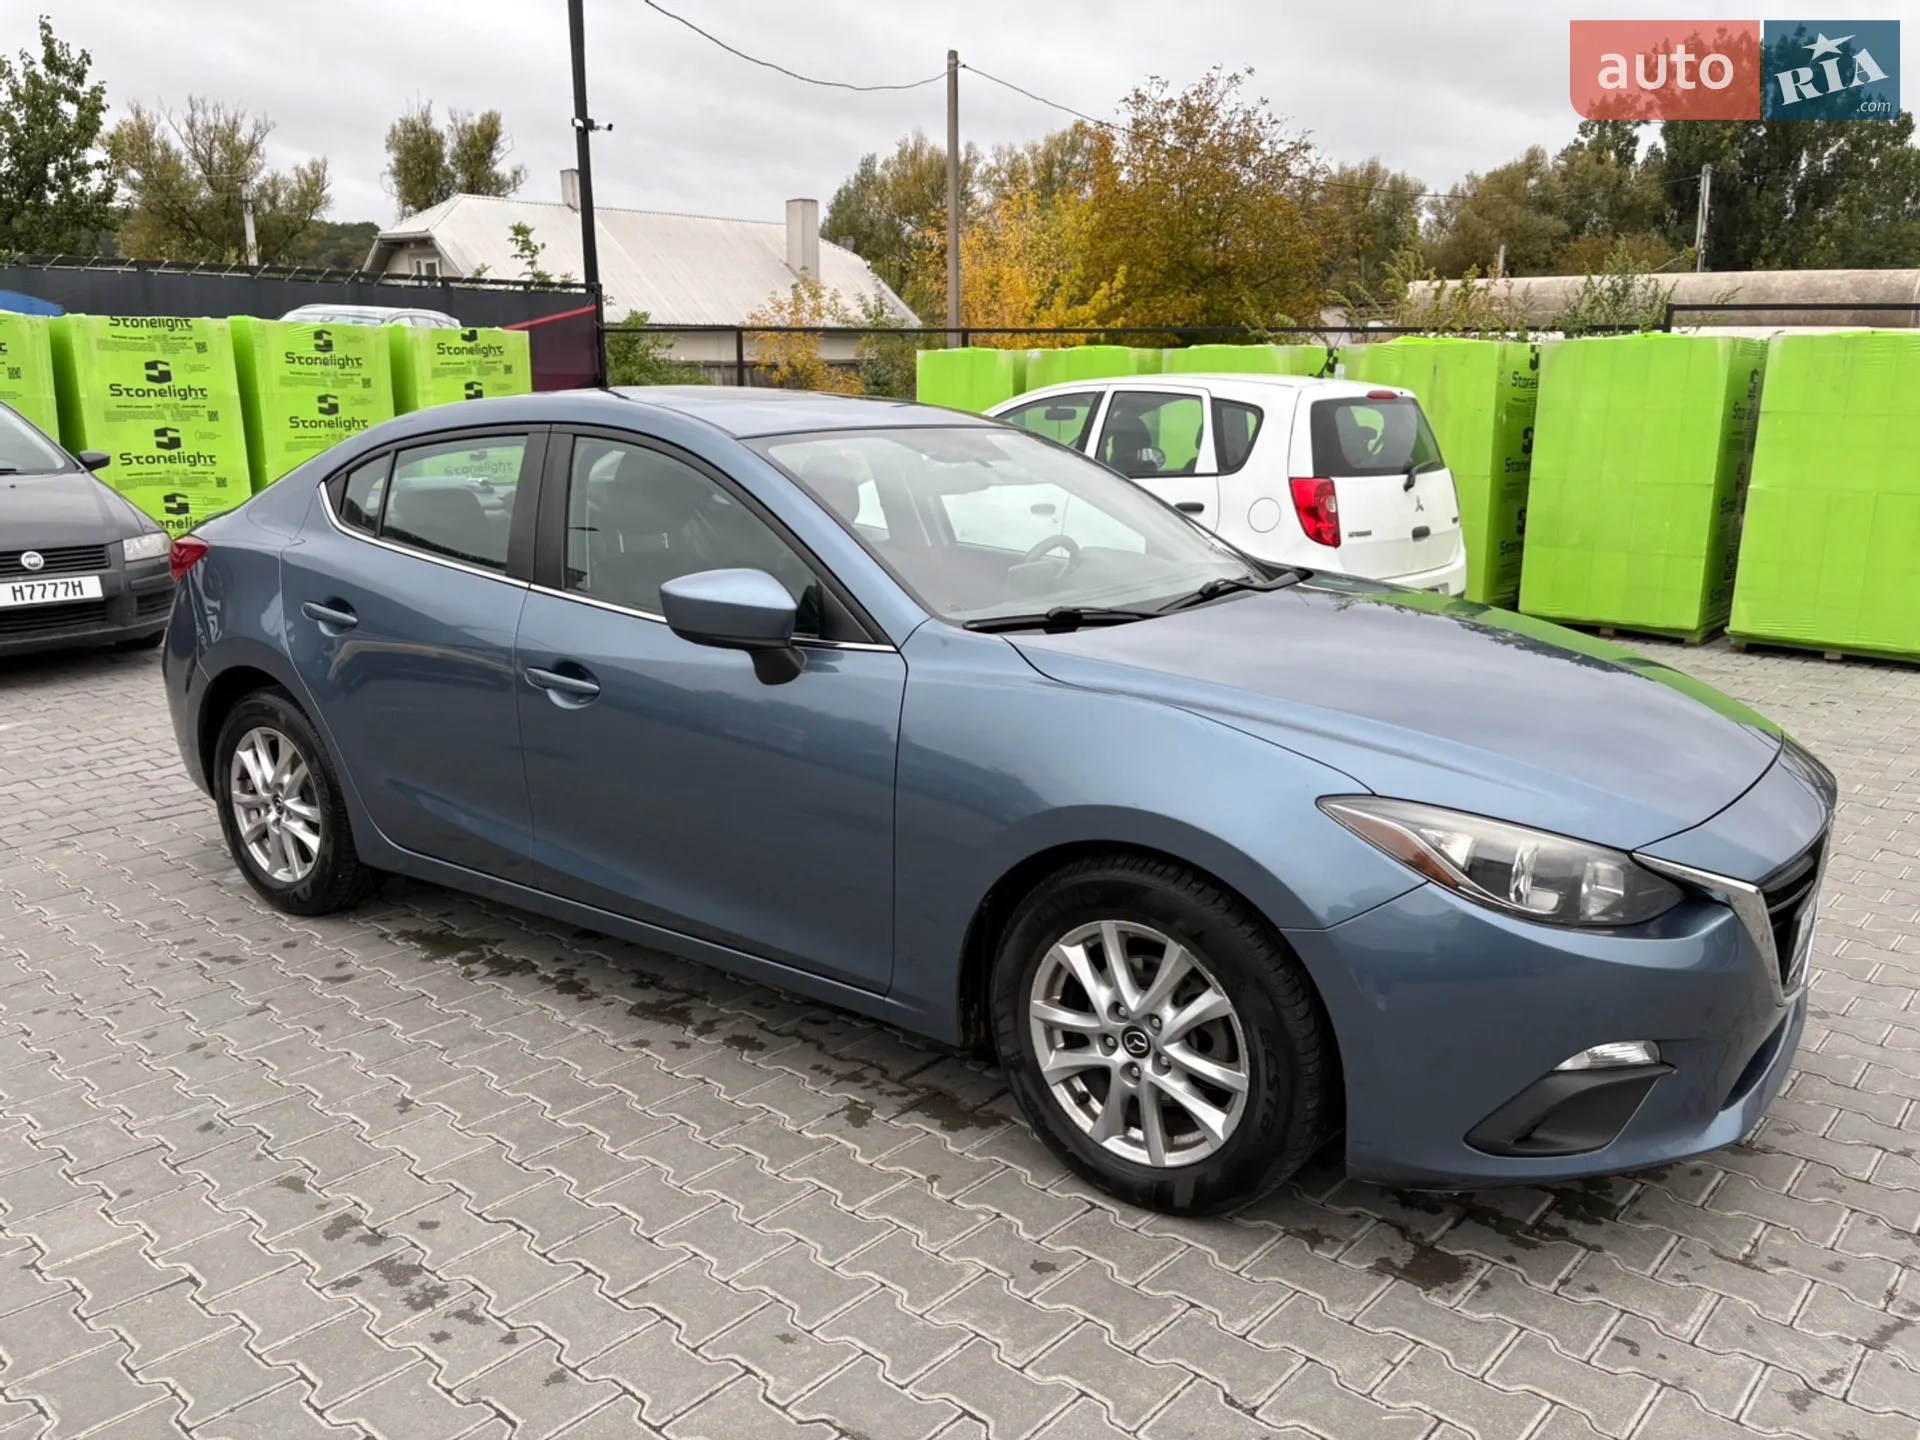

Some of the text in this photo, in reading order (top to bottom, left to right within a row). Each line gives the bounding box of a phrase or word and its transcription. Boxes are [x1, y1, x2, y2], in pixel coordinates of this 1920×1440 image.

[109, 316, 193, 332] Stonelight
[436, 342, 505, 358] Stonelight
[285, 352, 363, 369] Stonelight
[109, 383, 208, 401] Stonelight
[289, 416, 369, 432] Stonelight
[119, 451, 217, 467] Stonelight
[444, 460, 514, 476] Stonelight
[11, 580, 84, 602] H7777H
